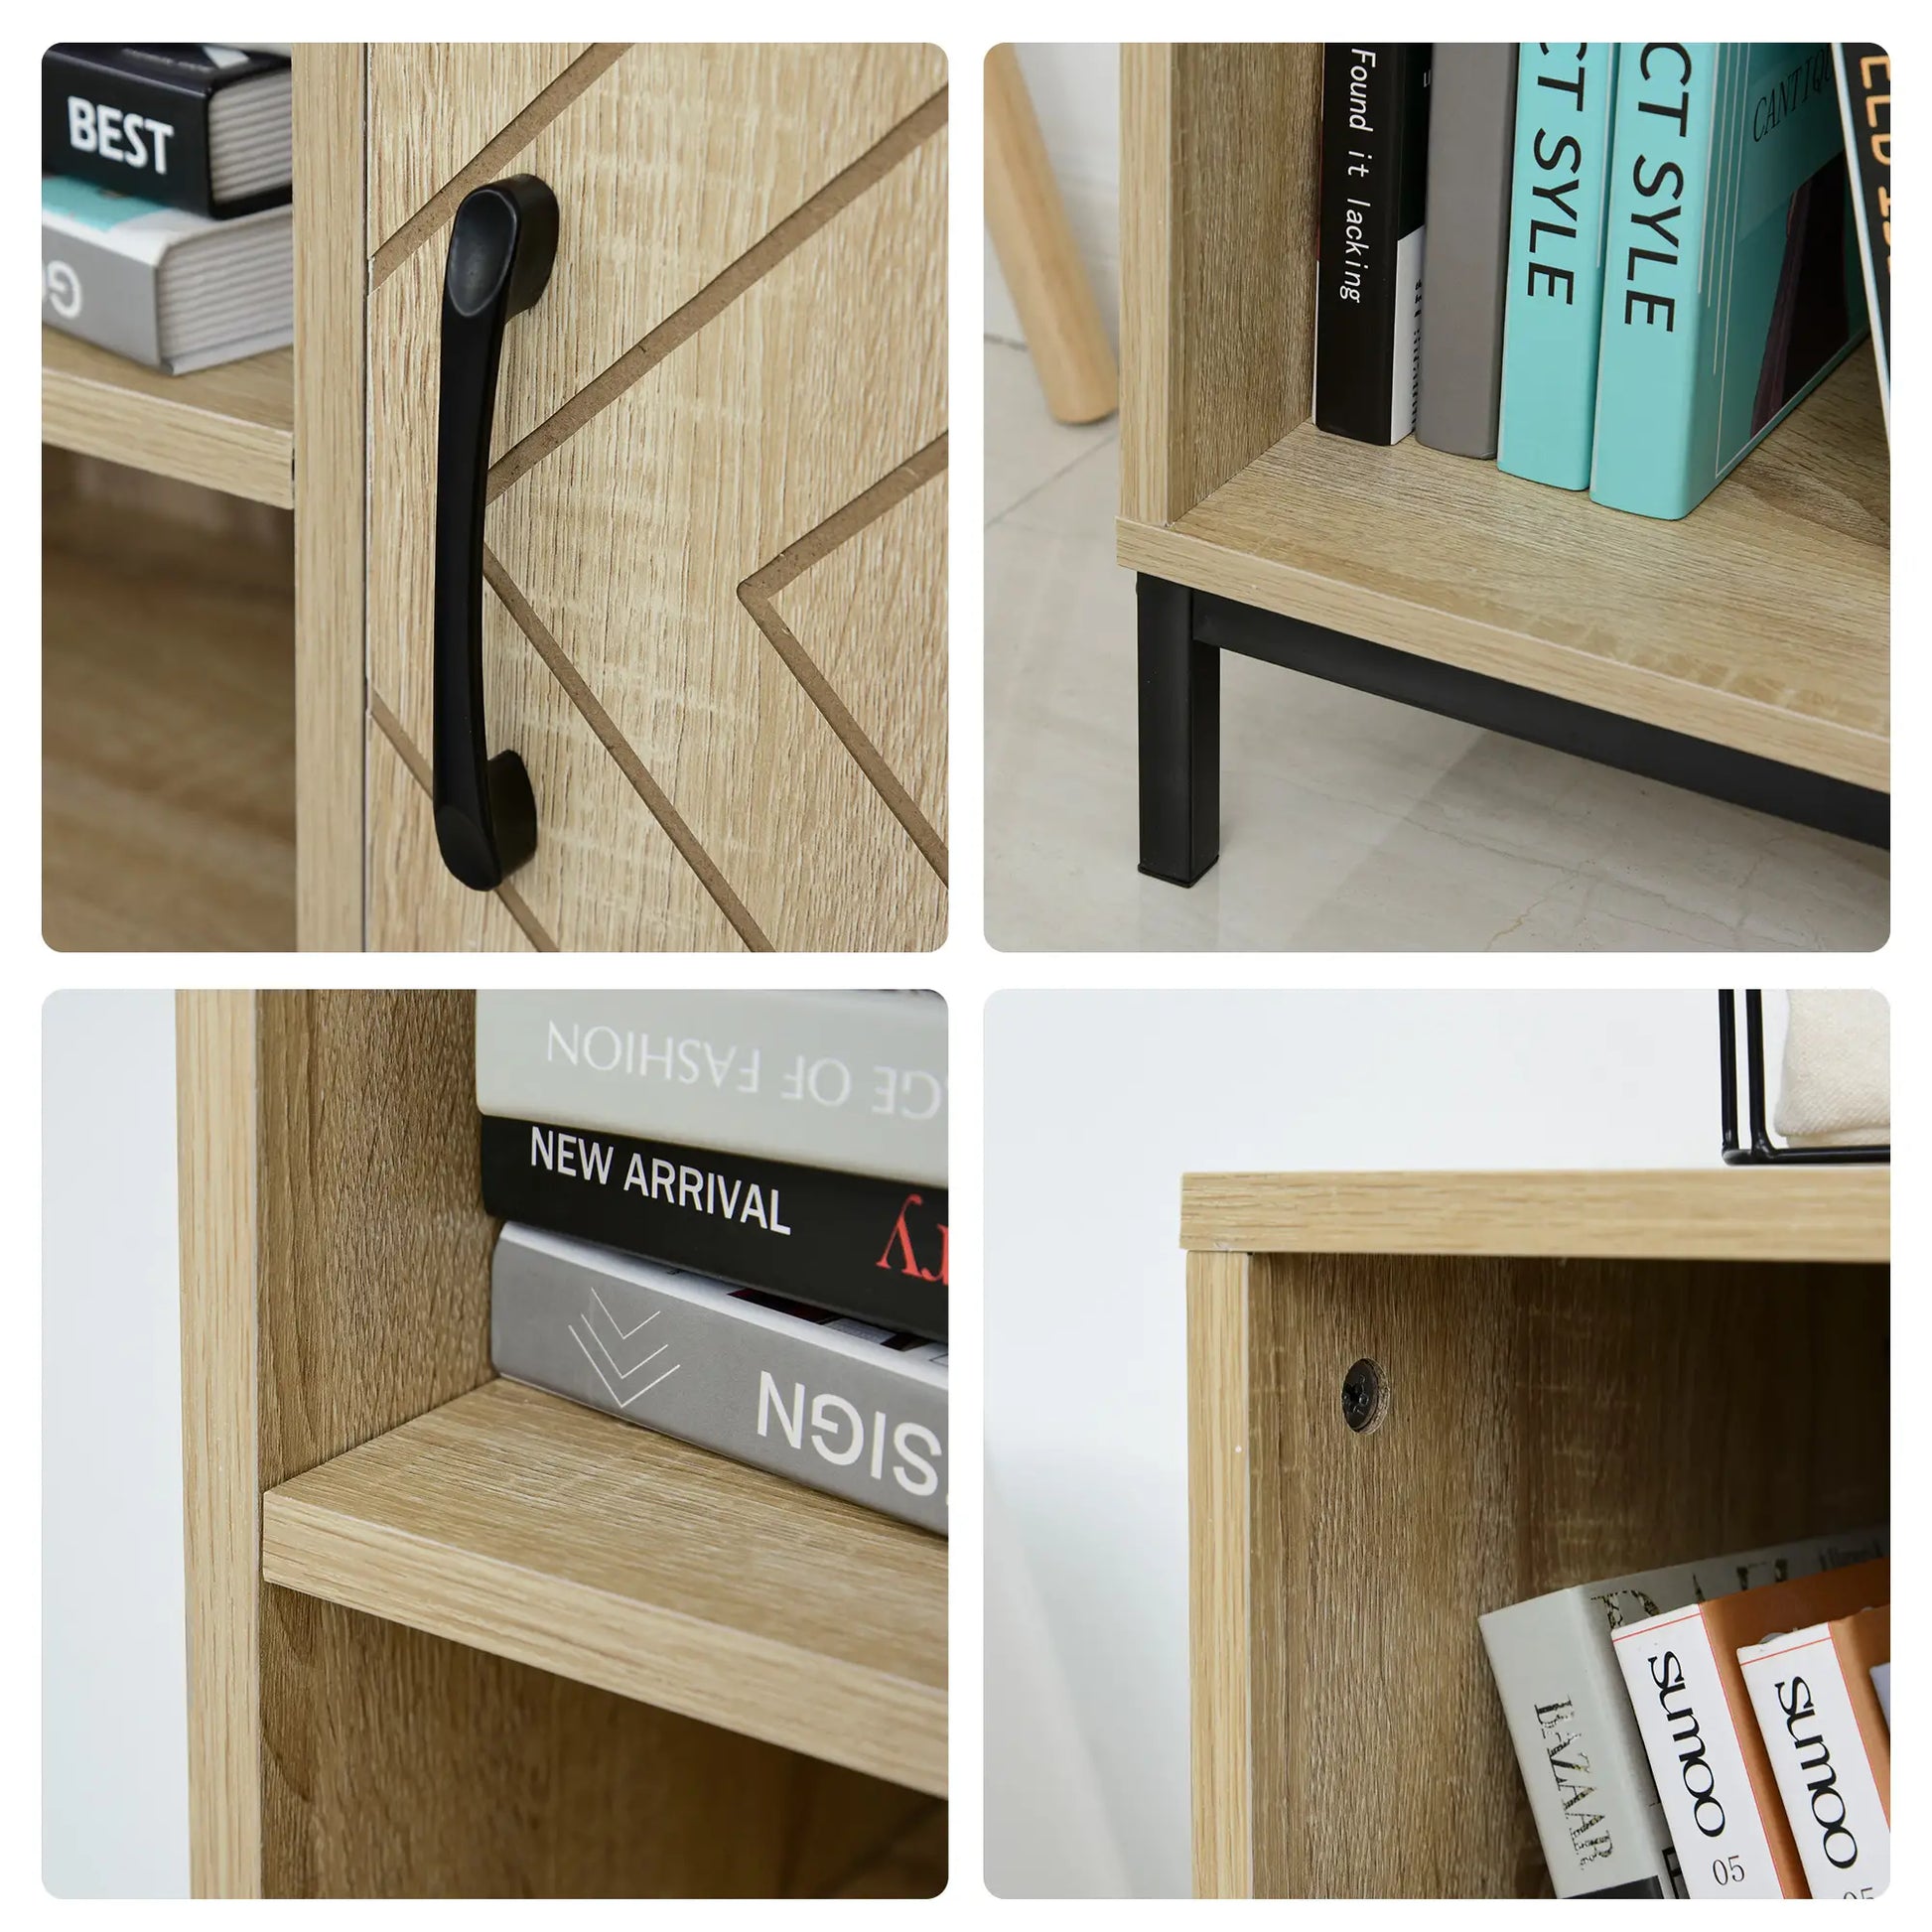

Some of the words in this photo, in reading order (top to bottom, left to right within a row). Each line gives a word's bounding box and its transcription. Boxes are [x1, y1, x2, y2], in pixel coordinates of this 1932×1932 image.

[1347, 48, 1377, 133] Found
[68, 95, 175, 175] BEST
[1347, 150, 1373, 178] it
[1339, 198, 1372, 304] lacking
[1527, 128, 1583, 306] SYLE
[1624, 154, 1684, 333] SYLE
[546, 1020, 760, 1093] FASHION
[781, 1054, 852, 1107] OF
[872, 1065, 948, 1120] GE
[530, 1126, 615, 1184] NEW
[622, 1153, 791, 1236] ARRIVAL
[757, 1370, 948, 1505] SIGN
[1534, 1694, 1613, 1870] BAZAAR
[1713, 1855, 1745, 1886] 05
